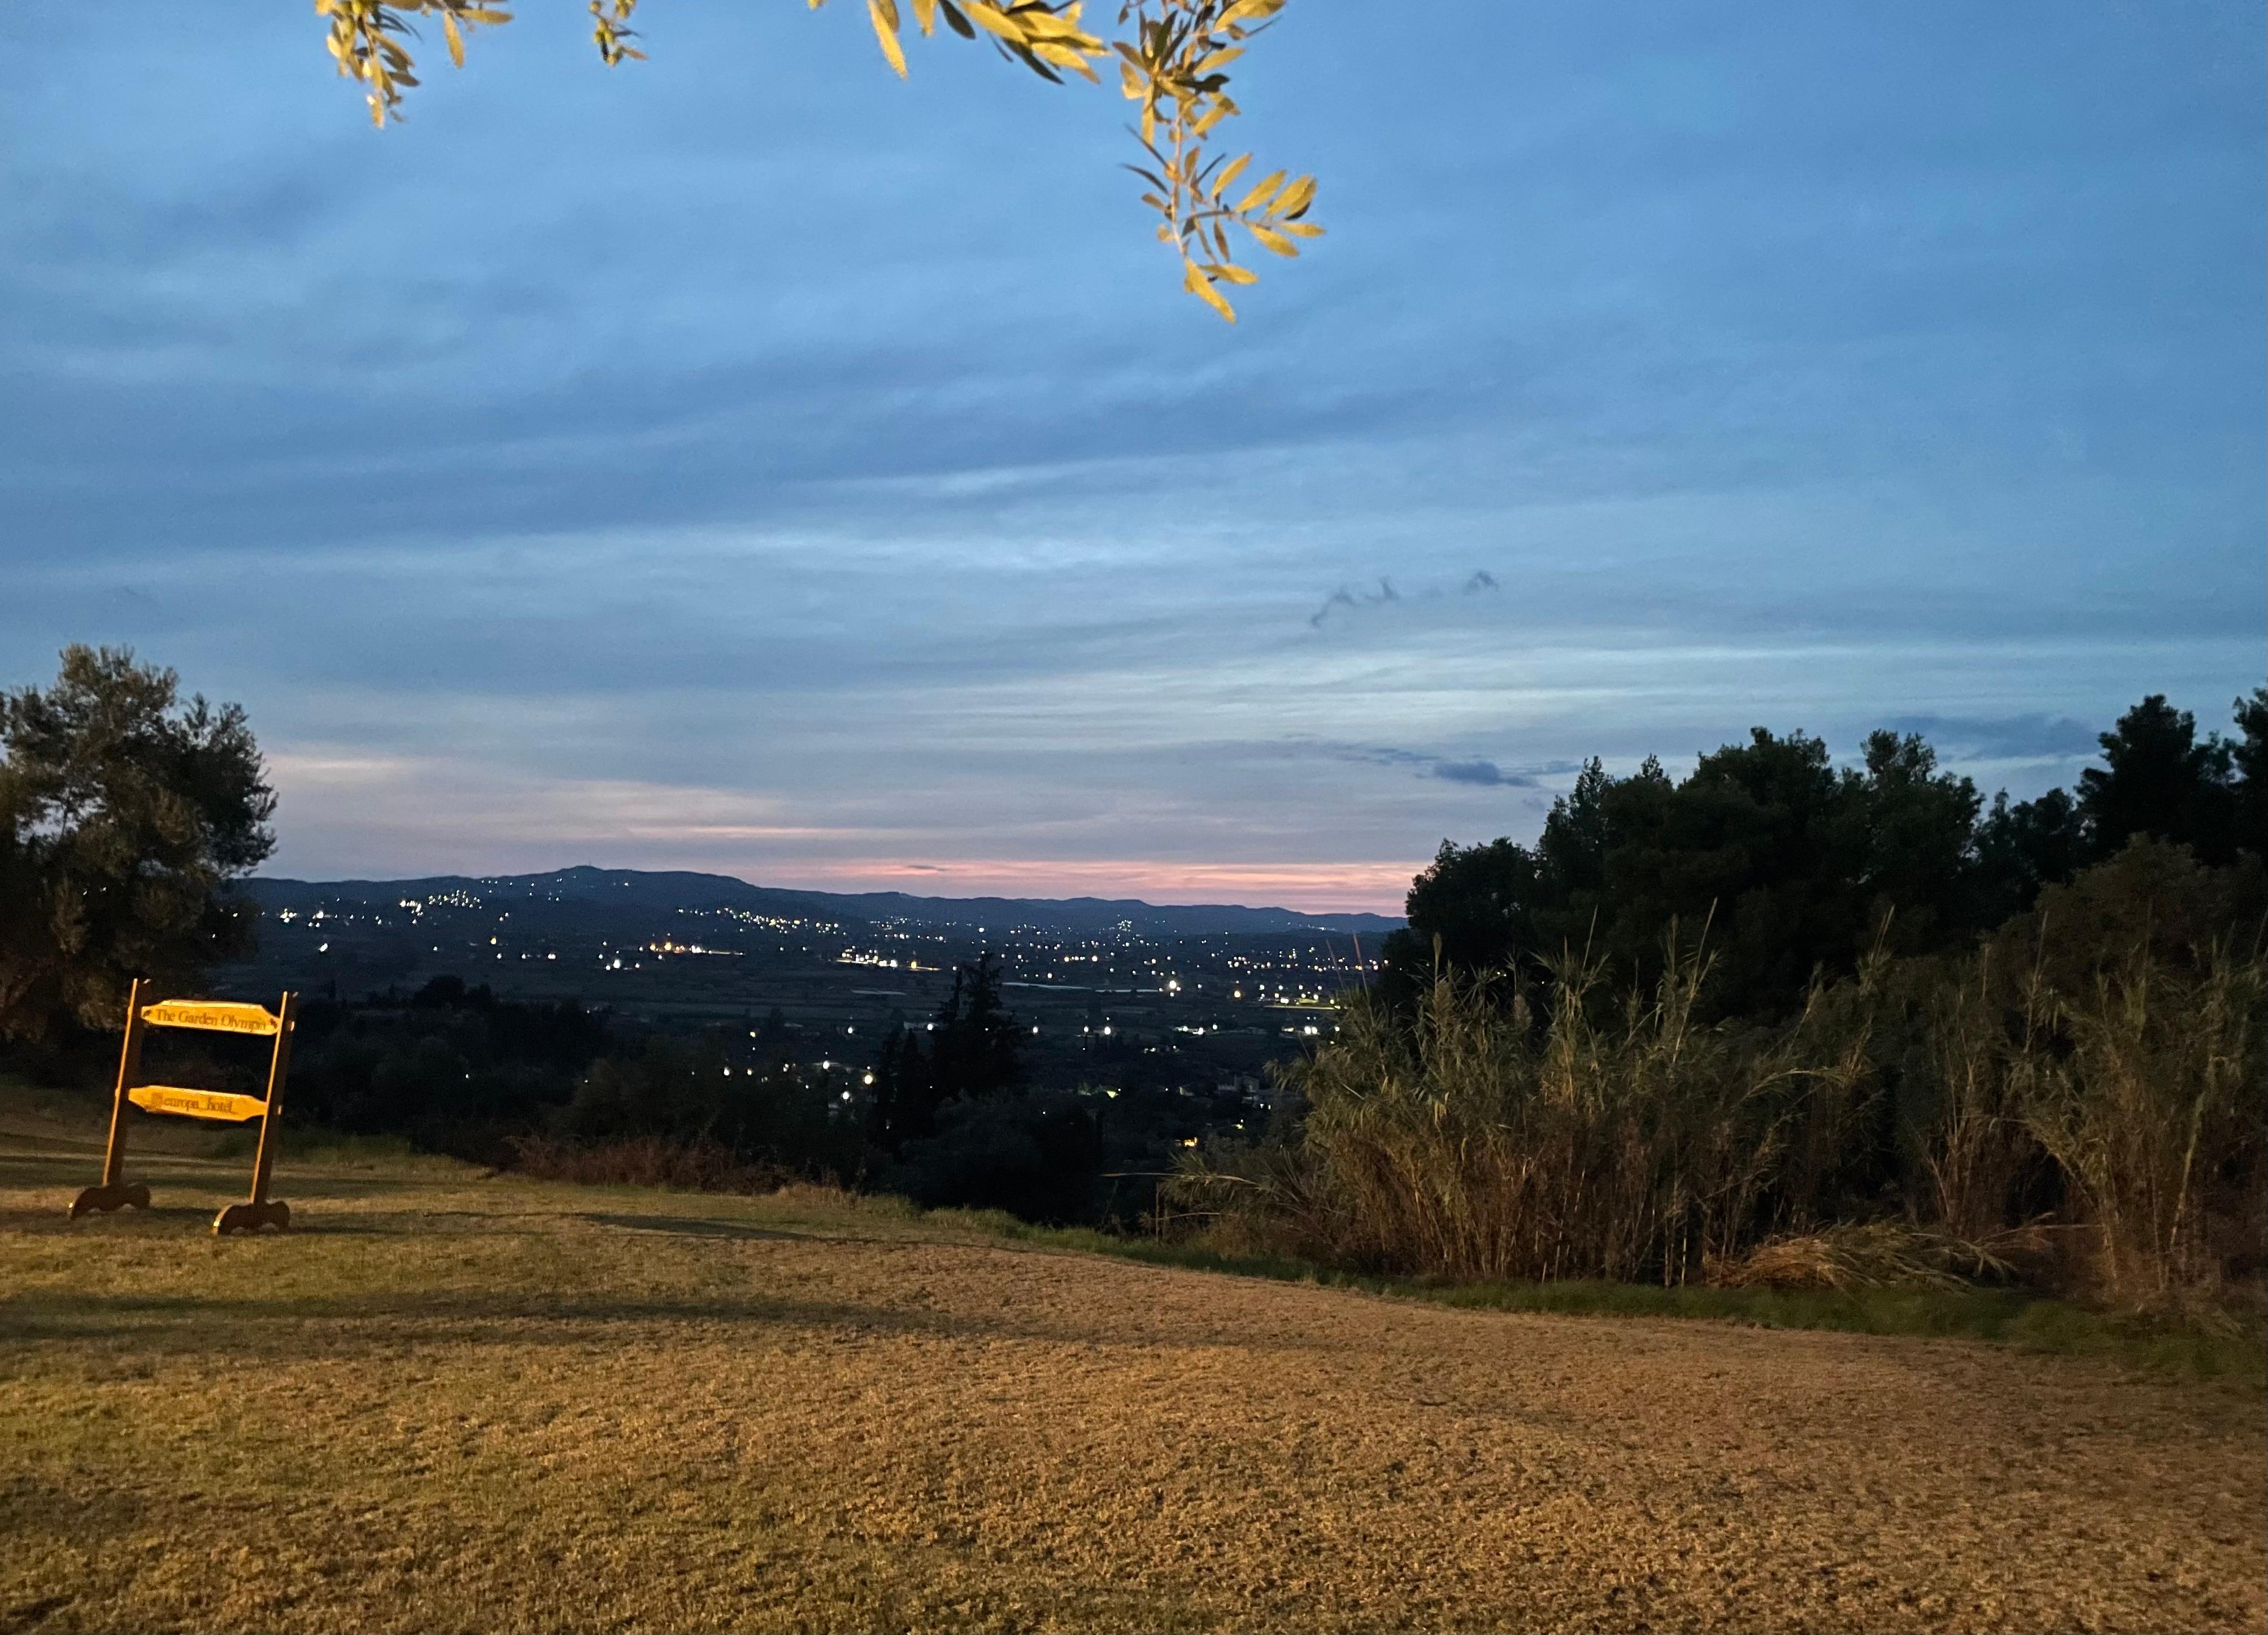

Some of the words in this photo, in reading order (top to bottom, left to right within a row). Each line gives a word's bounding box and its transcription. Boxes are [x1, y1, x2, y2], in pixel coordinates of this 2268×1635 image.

[155, 1009, 175, 1022] The
[179, 1011, 217, 1026] Garden
[221, 1014, 266, 1032] Olympia
